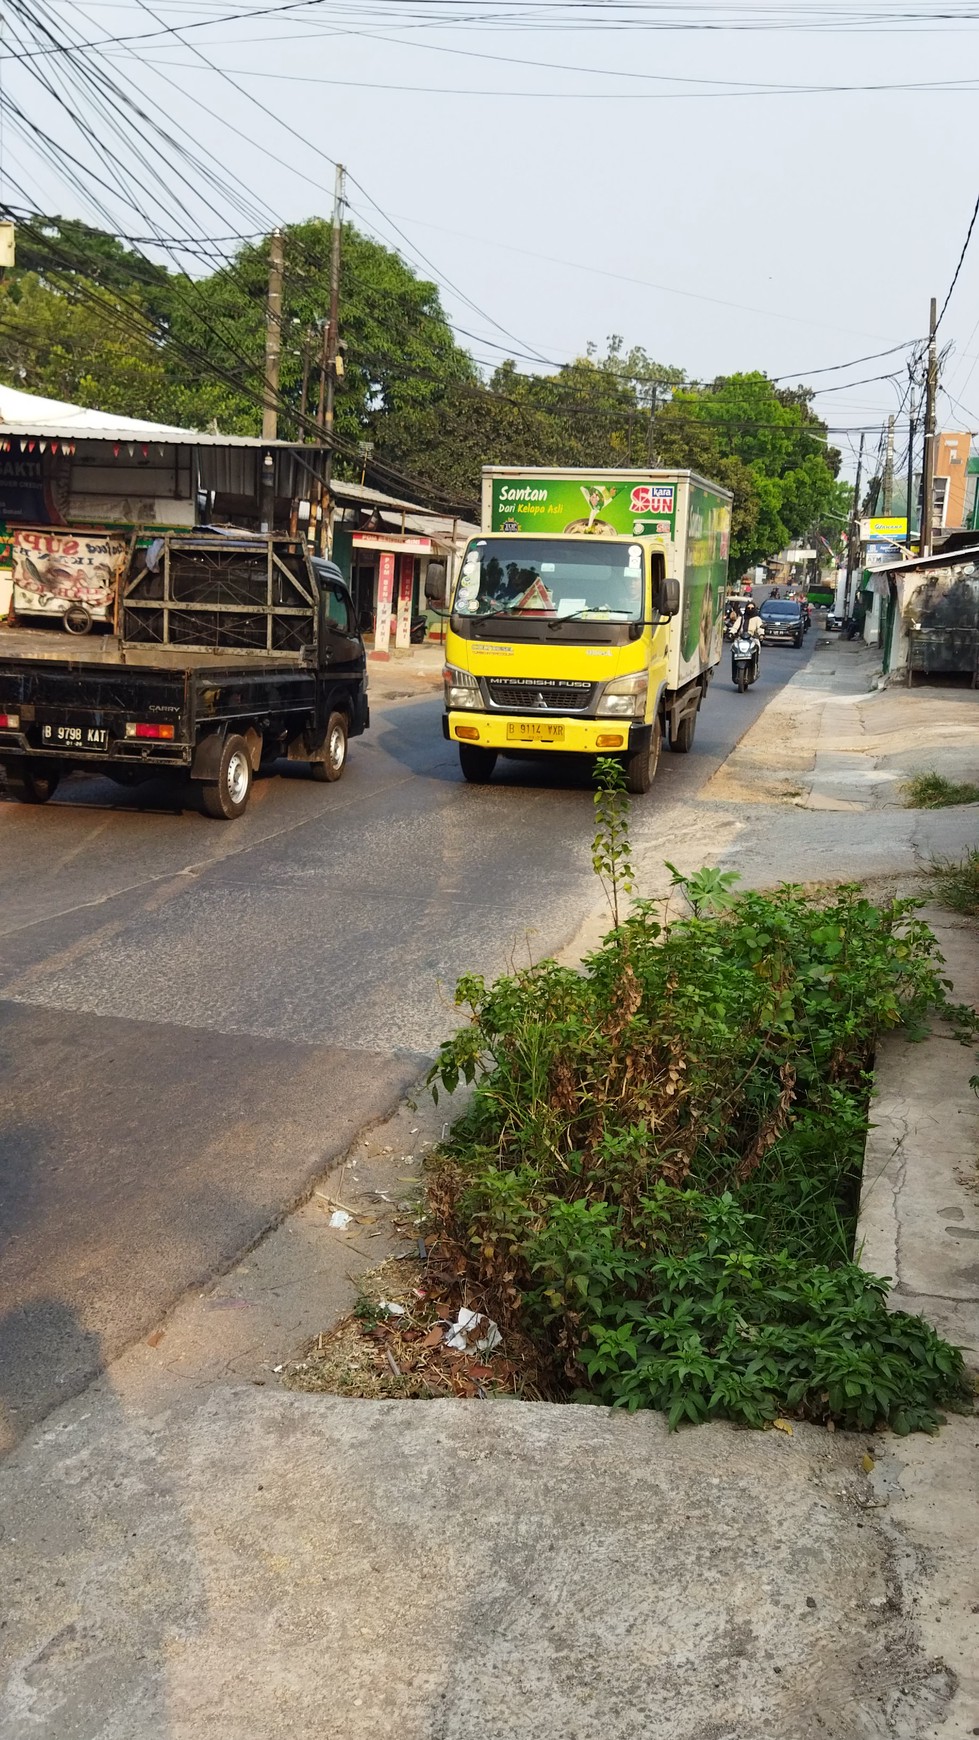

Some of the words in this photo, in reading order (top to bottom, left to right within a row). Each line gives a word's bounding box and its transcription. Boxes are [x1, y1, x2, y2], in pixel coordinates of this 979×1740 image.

[499, 485, 548, 501] Santan
[653, 487, 672, 497] kara
[631, 487, 673, 512] SUN
[498, 503, 516, 513] Dari
[517, 503, 545, 516] Kelapa
[547, 503, 564, 514] Asli
[490, 678, 555, 686] MITSUBISHI
[558, 680, 592, 688] FUSO
[148, 705, 180, 713] CARRY
[44, 725, 52, 738] B
[57, 727, 82, 740] 9798
[87, 729, 107, 743] KAT
[509, 723, 515, 734] B
[520, 724, 541, 735] 9114
